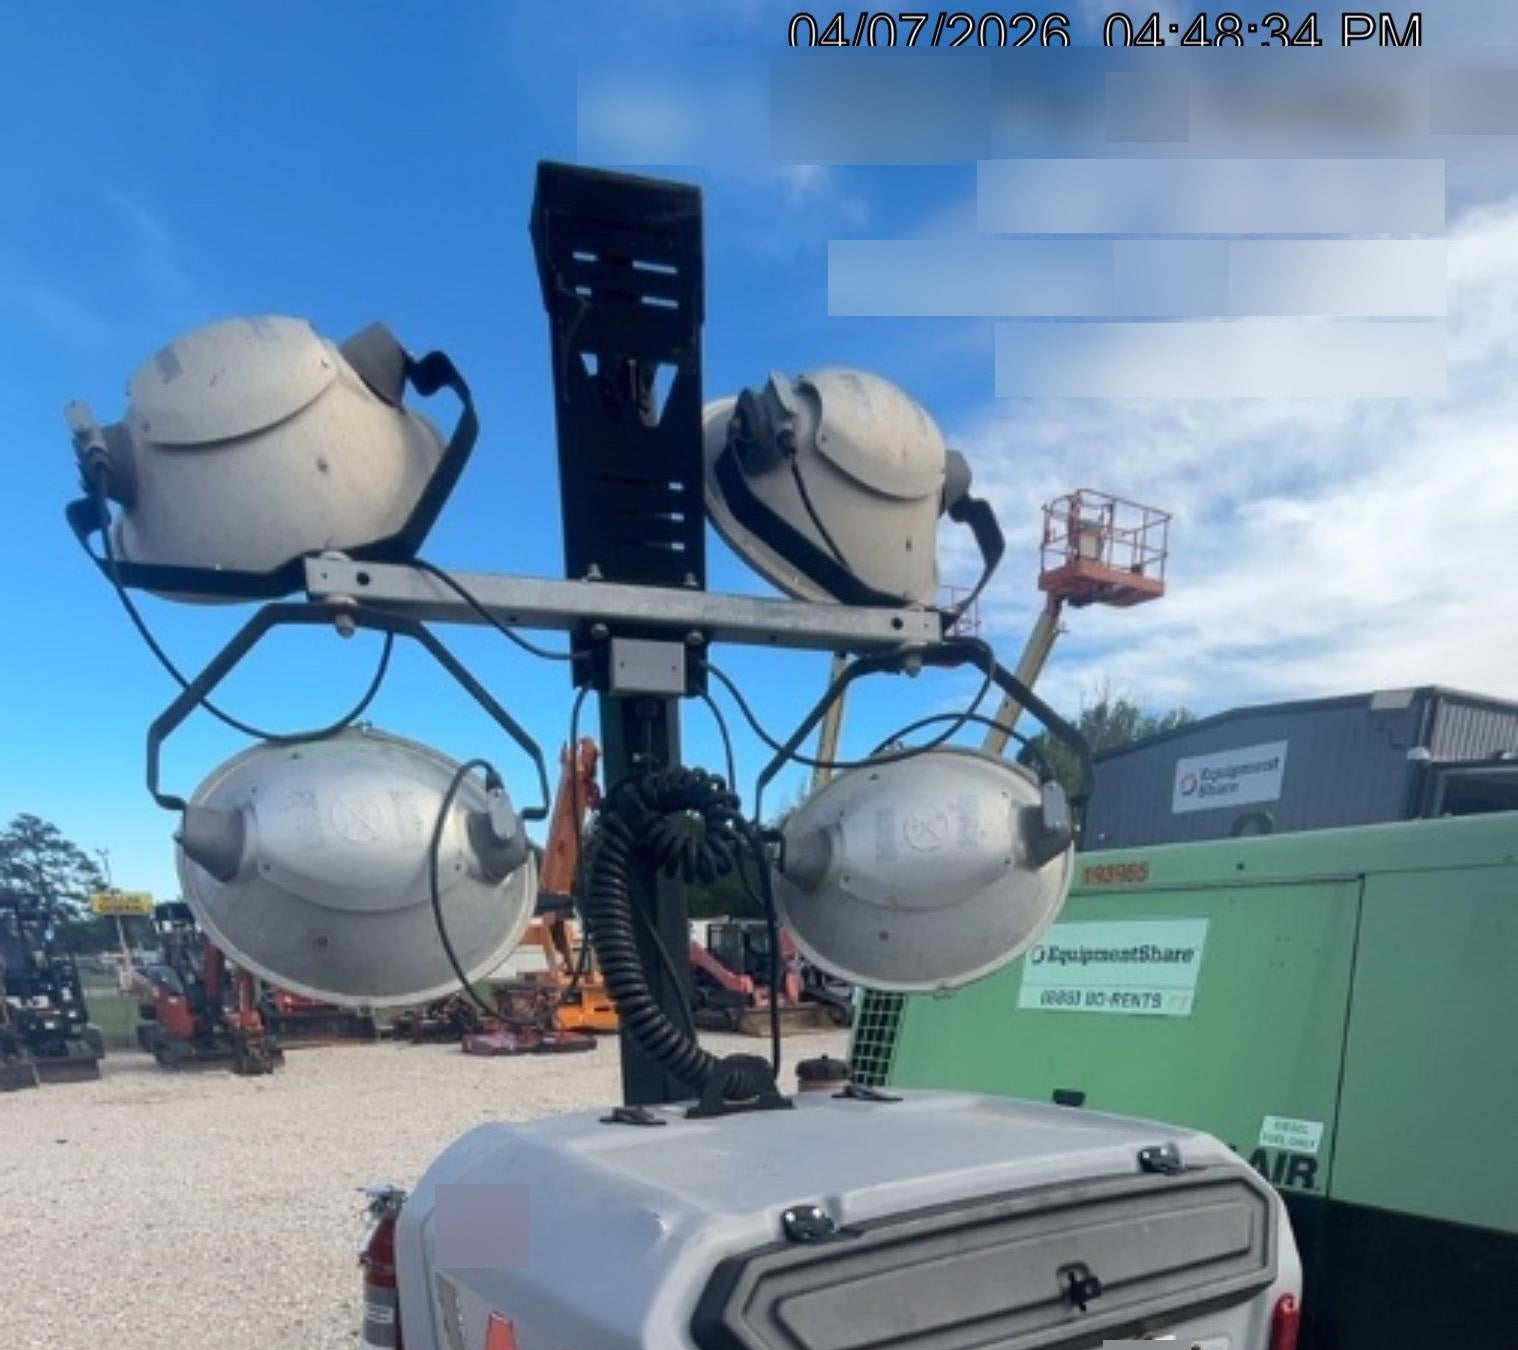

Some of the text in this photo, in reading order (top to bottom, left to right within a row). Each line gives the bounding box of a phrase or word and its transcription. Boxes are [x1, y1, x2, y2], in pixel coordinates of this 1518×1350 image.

[1200, 756, 1279, 783] Equipment
[1199, 782, 1239, 798] Share
[1047, 944, 1194, 967] EquipmentShare
[1230, 1145, 1318, 1190] AIR
